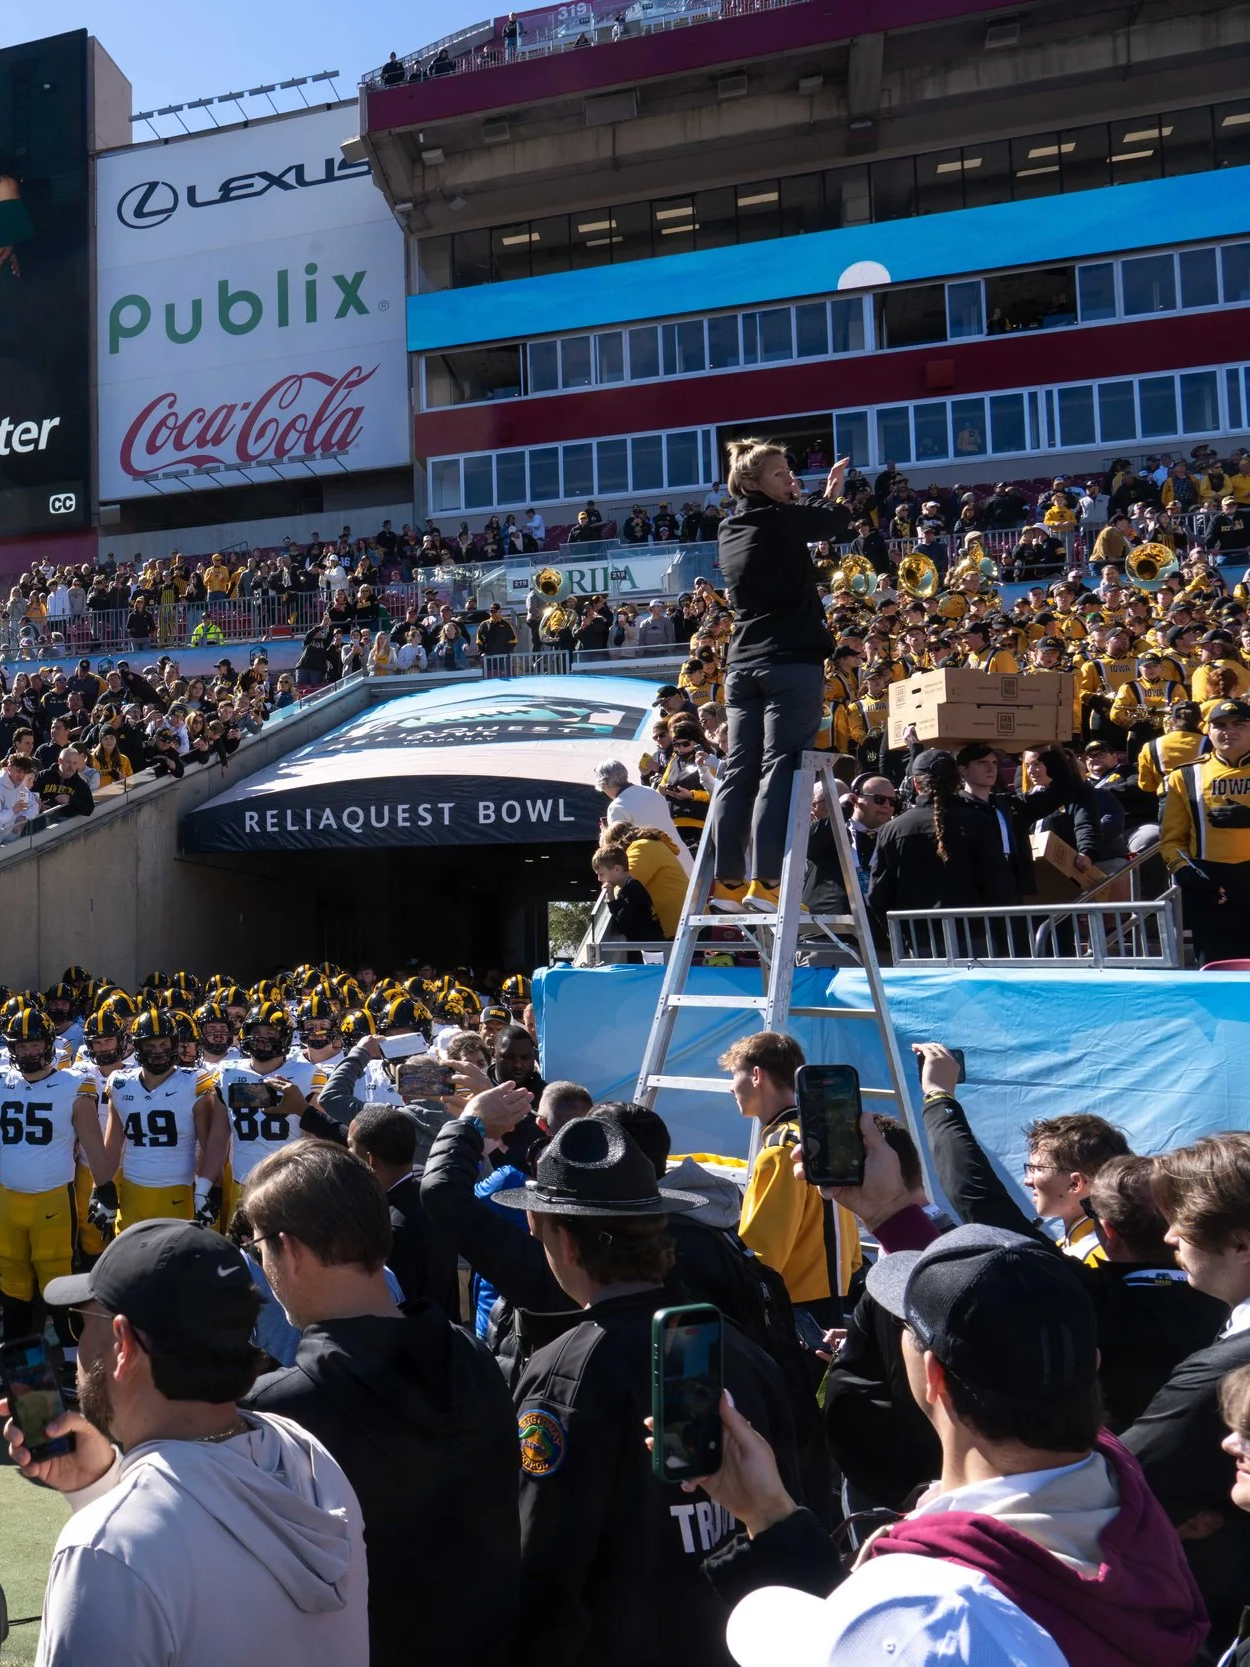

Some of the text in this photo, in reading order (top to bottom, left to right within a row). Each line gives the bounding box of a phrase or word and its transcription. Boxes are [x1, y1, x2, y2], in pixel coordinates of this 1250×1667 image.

[558, 2, 587, 20] 319
[186, 157, 374, 209] LEXUS
[119, 362, 382, 478] Coca-Cola
[52, 495, 74, 512] CC
[513, 580, 528, 588] 219
[1110, 664, 1131, 673] IOWA
[1144, 688, 1165, 697] IOWA
[866, 702, 887, 712] IOWA
[1211, 778, 1250, 796] IOWA
[244, 798, 576, 834] RELIAQUEST BOWL
[0, 1100, 53, 1146] 65
[123, 1109, 178, 1148] 49
[233, 1106, 290, 1142] 88
